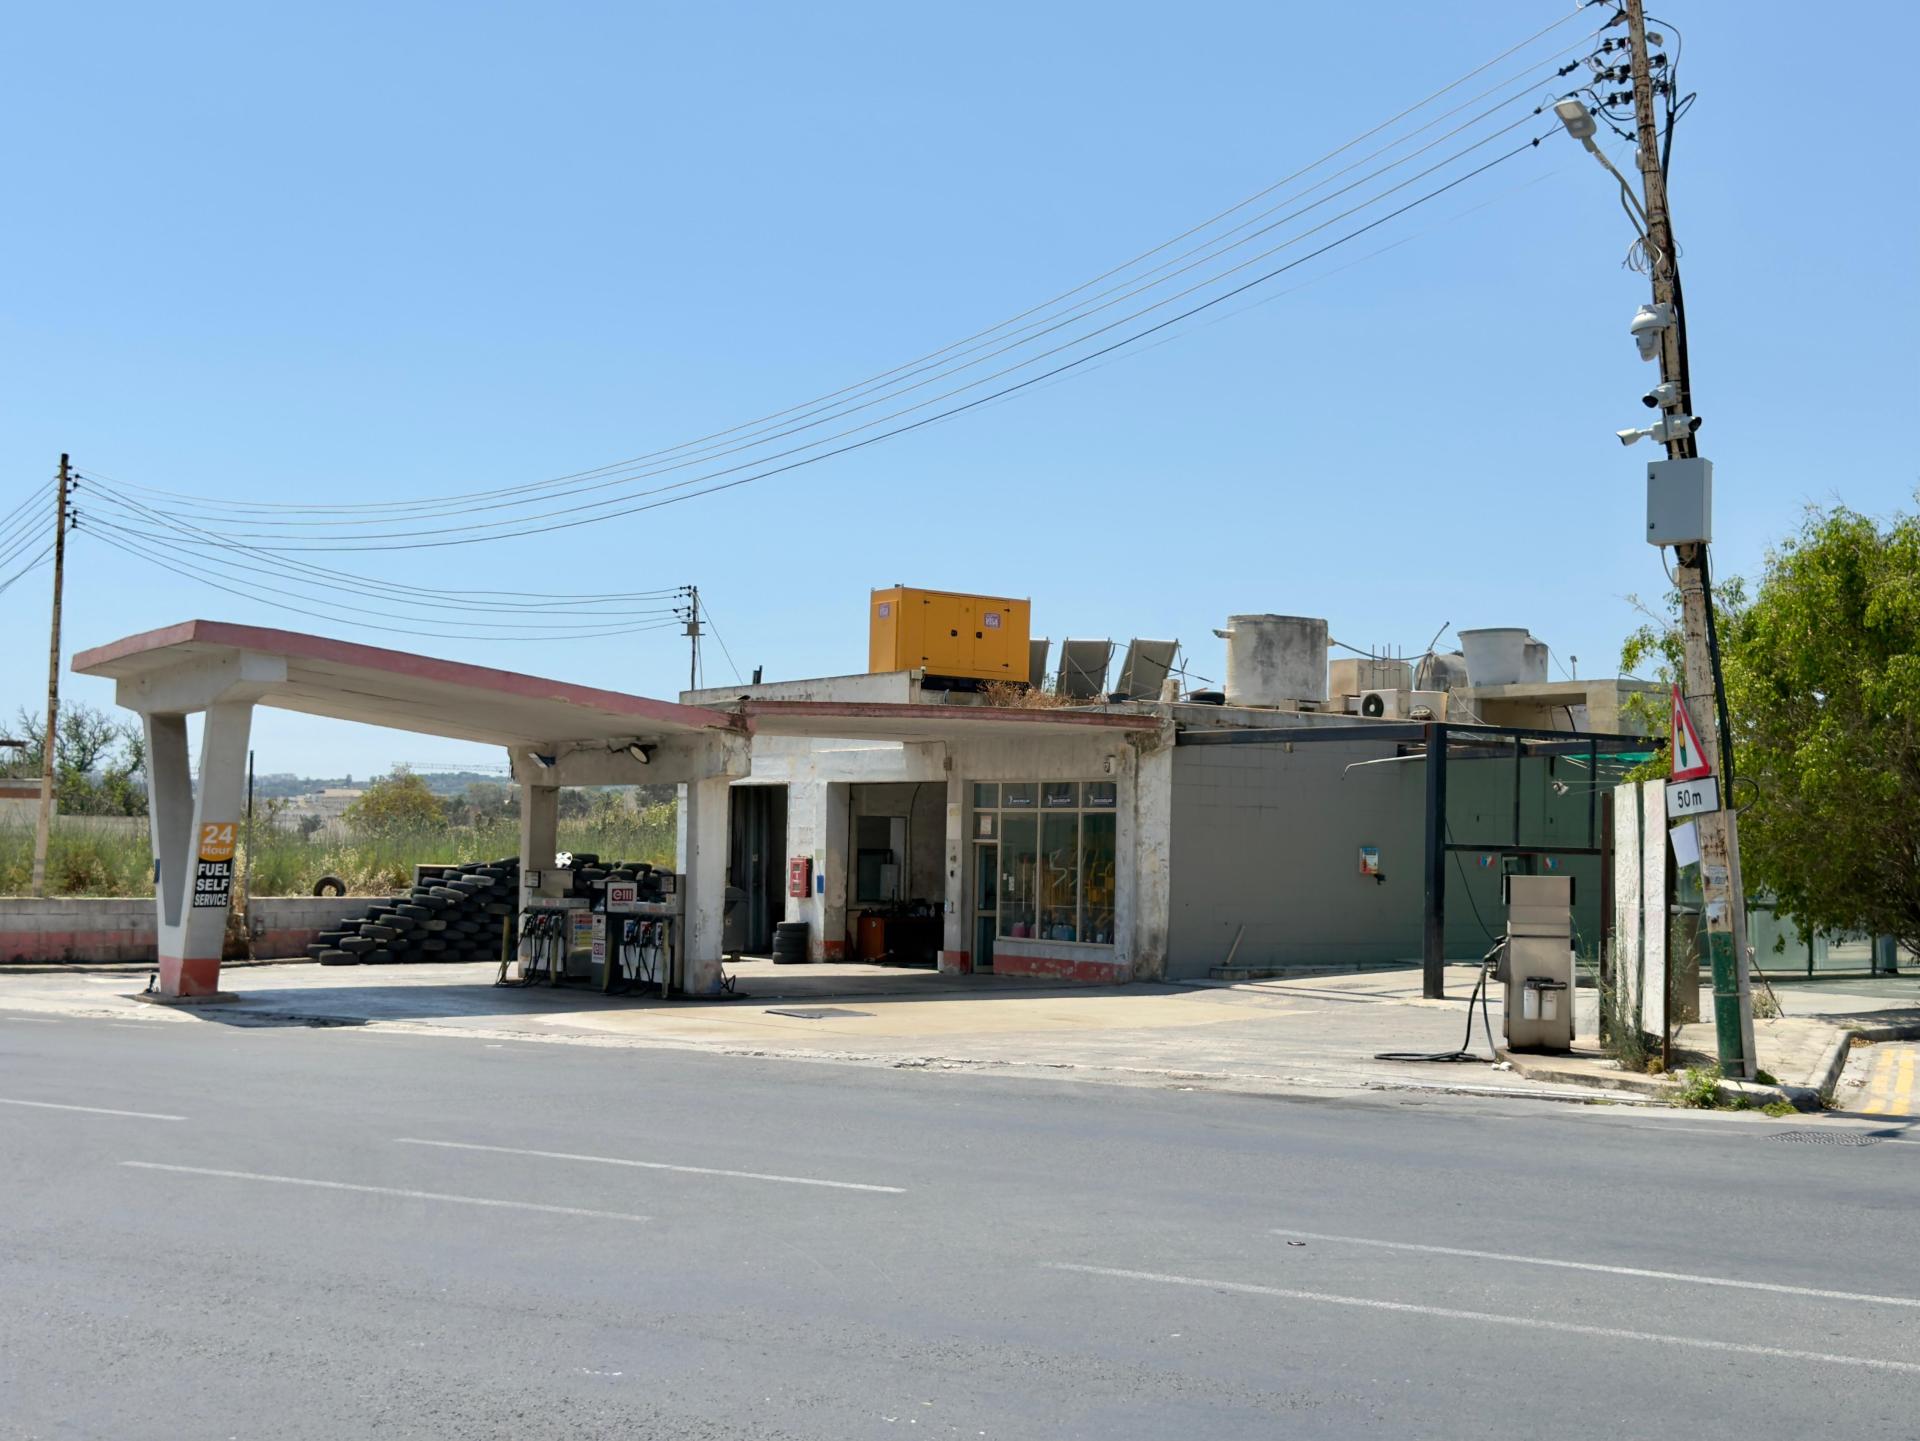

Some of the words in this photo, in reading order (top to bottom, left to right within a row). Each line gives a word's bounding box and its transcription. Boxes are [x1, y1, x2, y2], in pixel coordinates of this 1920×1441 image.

[203, 825, 234, 844] 24
[201, 845, 231, 855] Hour
[198, 863, 230, 876] FUEL
[196, 879, 229, 891] SELF
[194, 893, 227, 906] SERVICE
